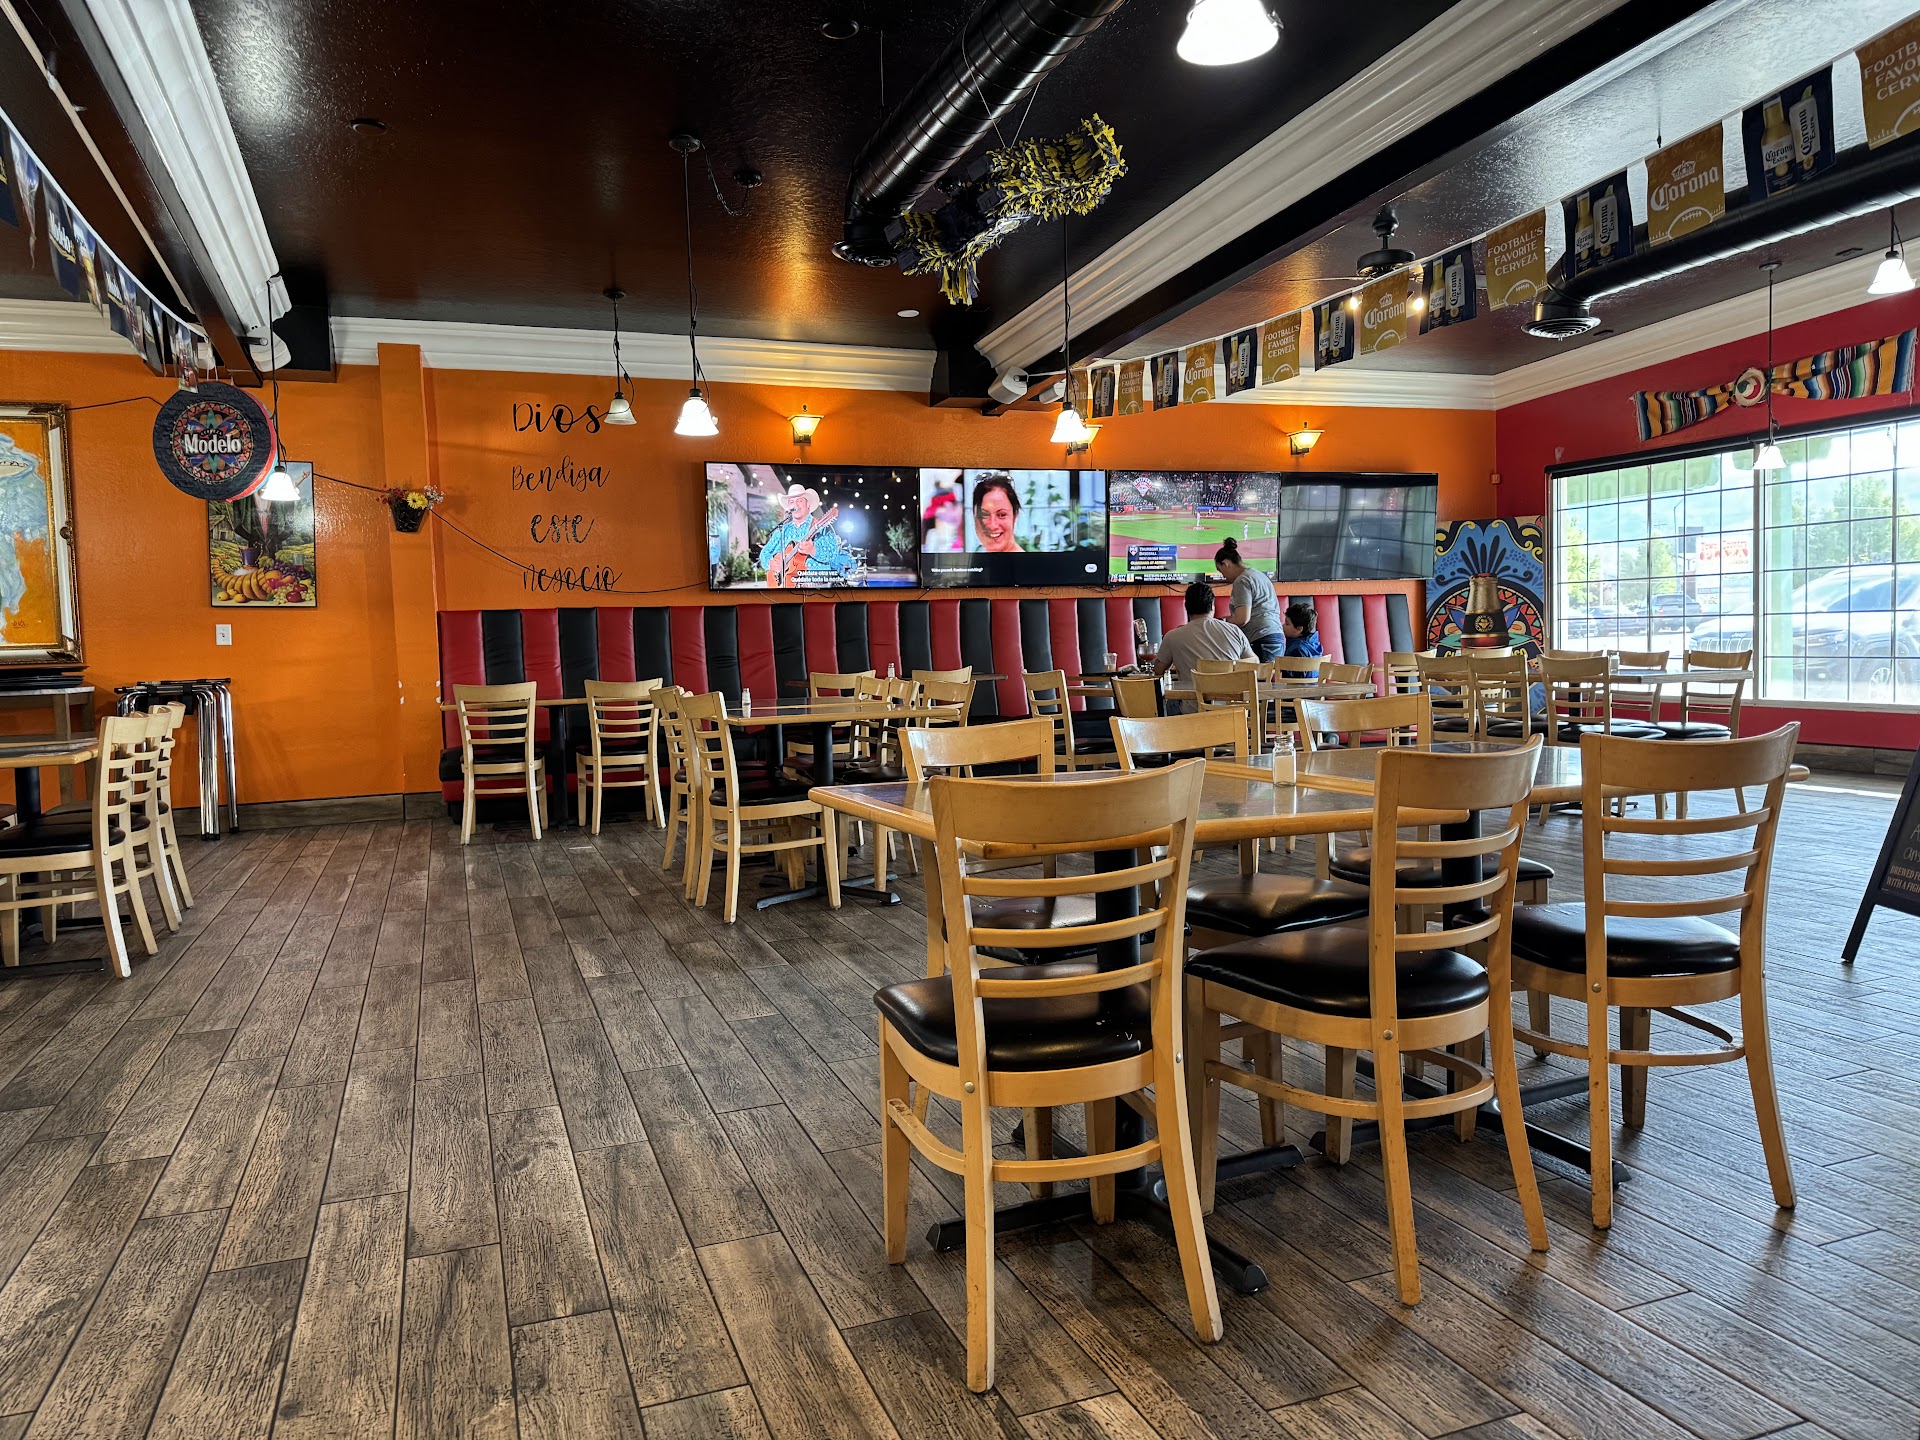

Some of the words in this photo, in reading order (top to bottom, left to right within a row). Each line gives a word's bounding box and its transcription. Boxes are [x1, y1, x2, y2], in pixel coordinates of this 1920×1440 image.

[1864, 41, 1920, 79] FOOTB
[1876, 55, 1920, 87] FAVO
[1877, 73, 1920, 100] CERV
[1799, 109, 1812, 156] Corona
[1765, 143, 1793, 162] Corona
[1650, 166, 1720, 211] Corona
[1600, 204, 1612, 244] Corona
[1487, 226, 1544, 258] FOOTBALL'S
[1494, 240, 1538, 266] FAVORITE
[1494, 252, 1538, 277] CERVEZA
[1450, 271, 1459, 306] Corona
[1363, 301, 1405, 329] Corona
[1264, 325, 1300, 342] FOOTBALL'S
[1267, 335, 1296, 350] FAVORITE
[1267, 343, 1296, 358] CERVEZA
[1185, 366, 1213, 385] Corona
[513, 402, 608, 433] Dios
[184, 433, 242, 454] Modelo
[512, 455, 610, 492] Bendiga
[531, 514, 594, 543] este
[523, 564, 623, 593] negocio
